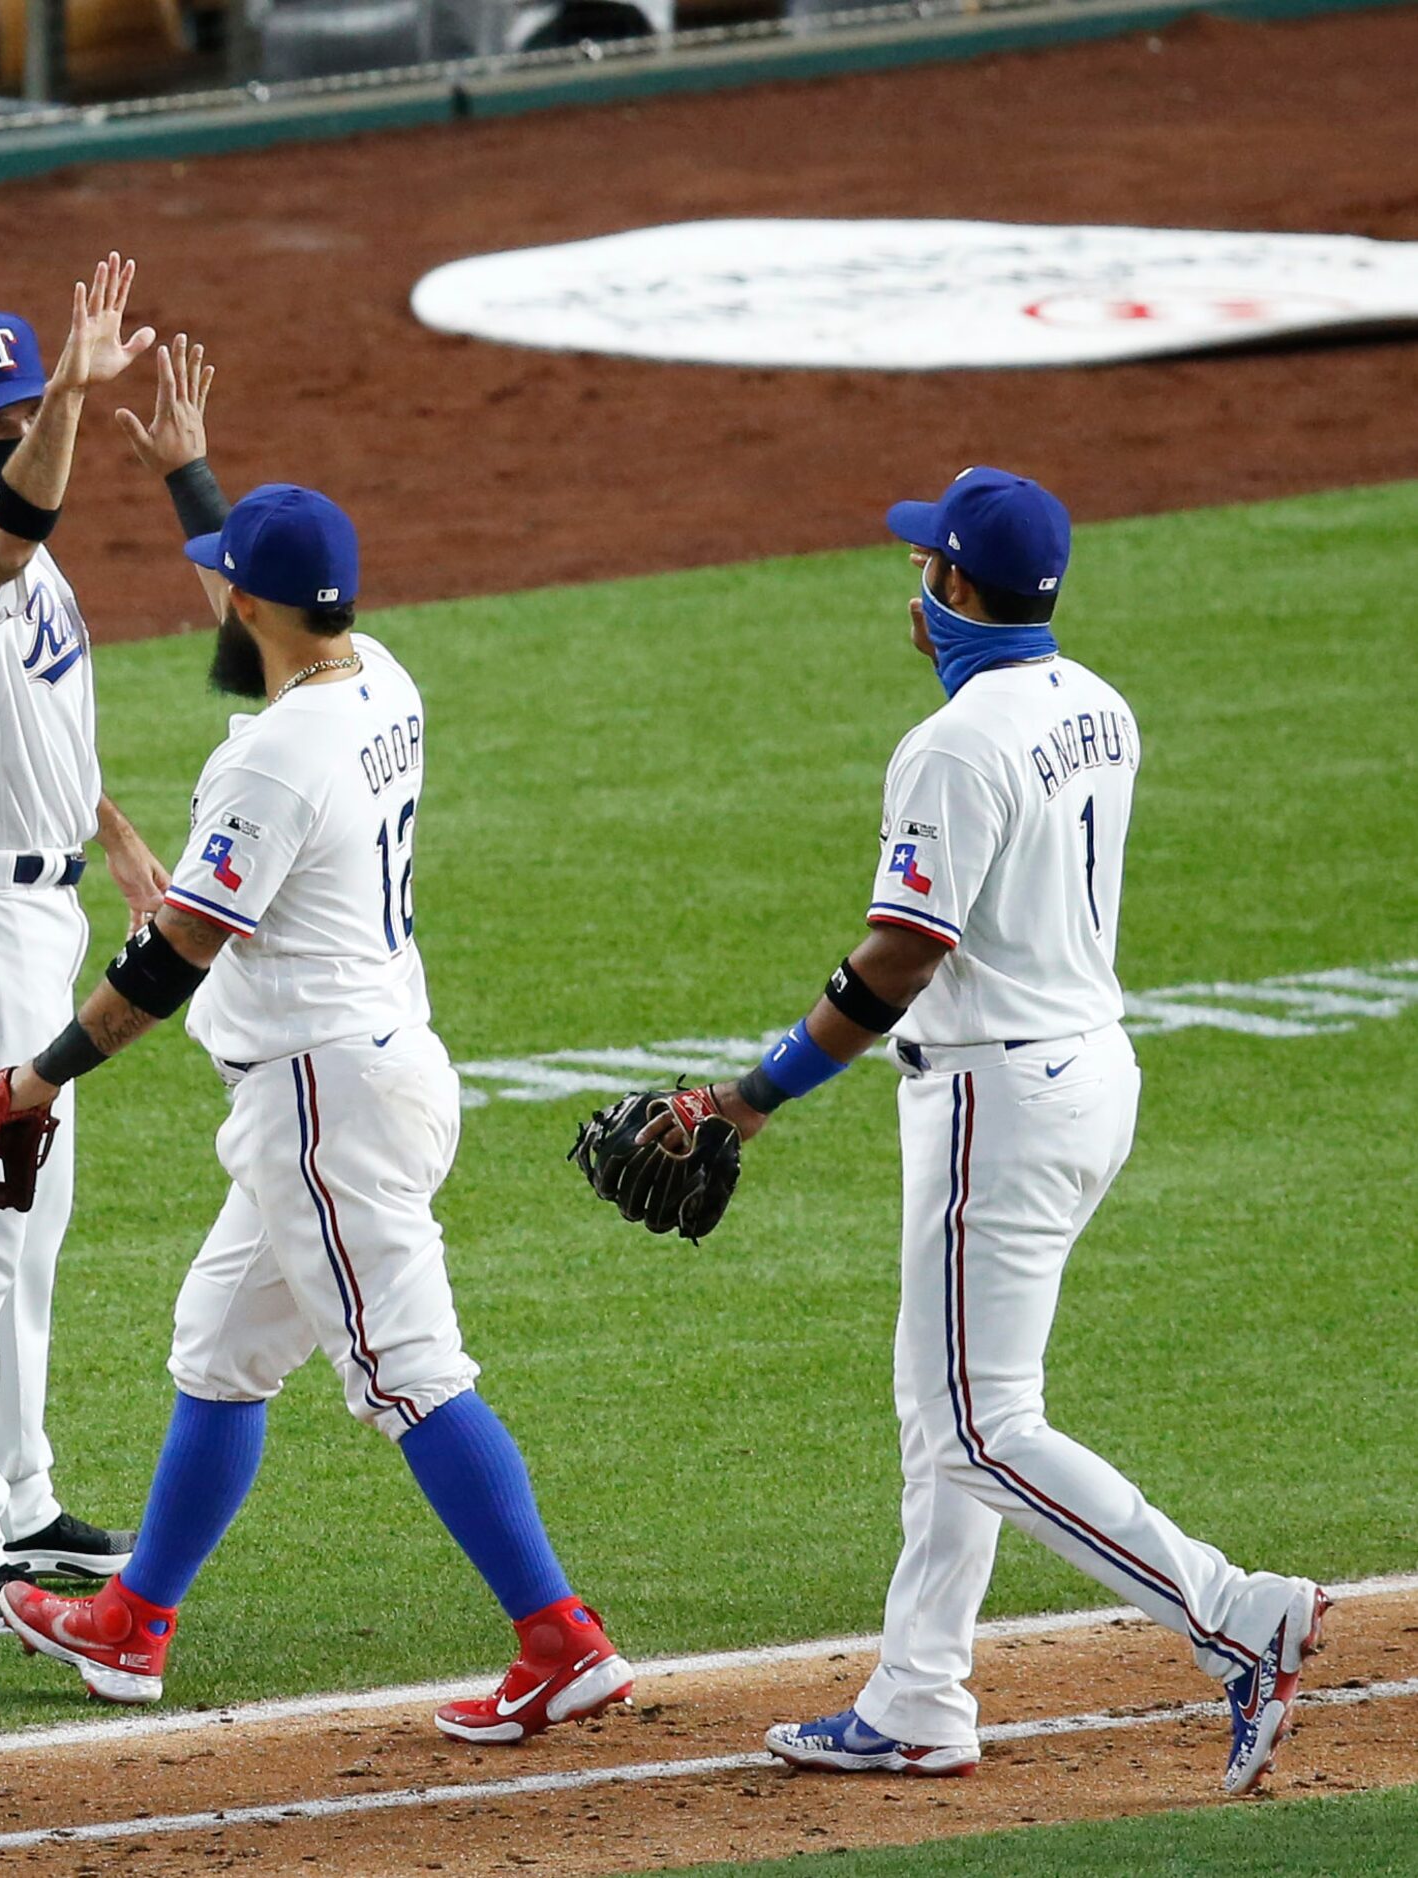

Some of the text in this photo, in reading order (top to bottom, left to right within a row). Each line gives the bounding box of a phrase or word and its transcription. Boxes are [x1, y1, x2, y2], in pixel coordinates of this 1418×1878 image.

[360, 714, 420, 797] ODOR
[374, 796, 414, 960] 12
[1079, 794, 1102, 940] 1
